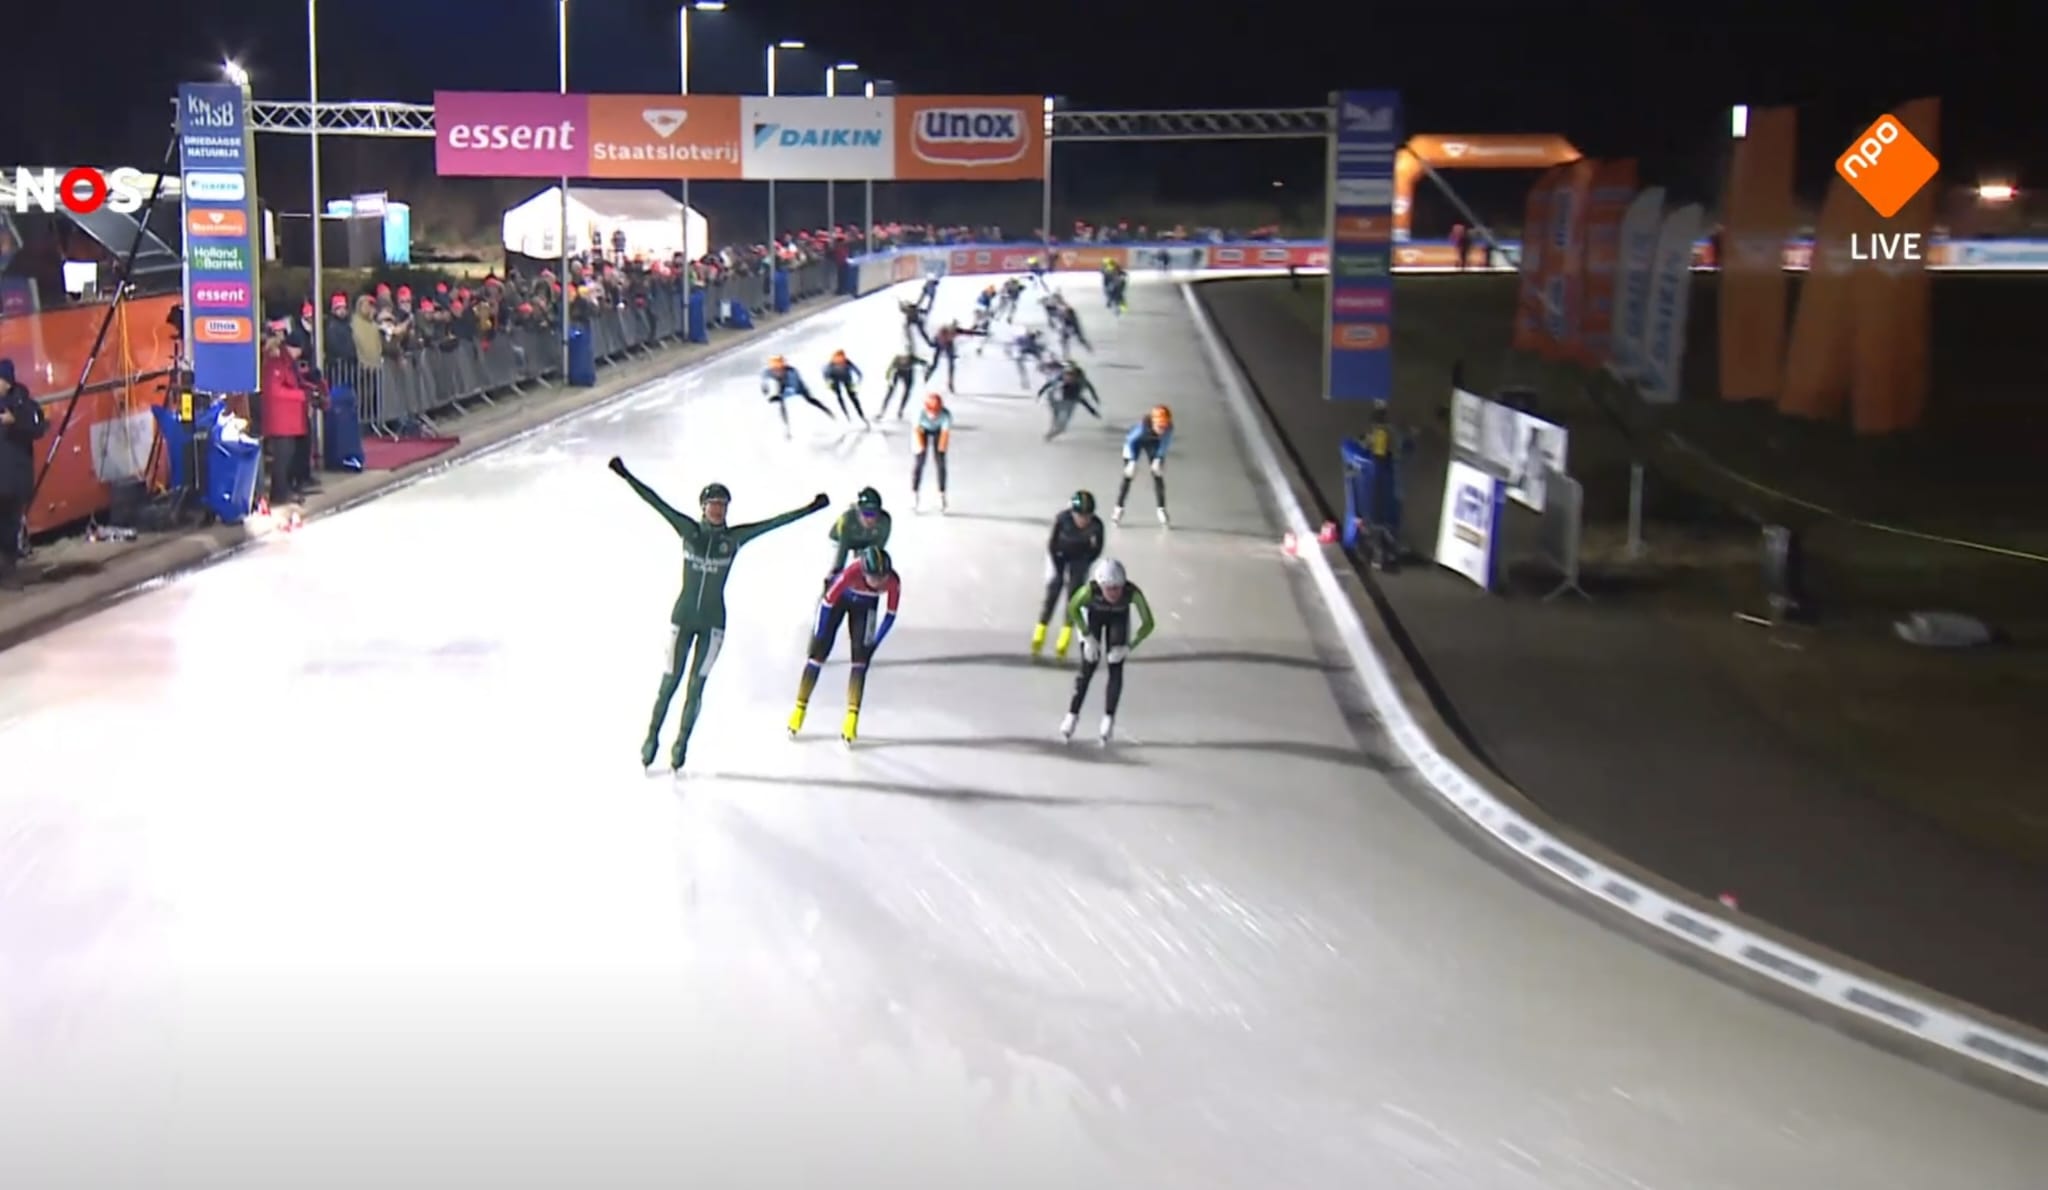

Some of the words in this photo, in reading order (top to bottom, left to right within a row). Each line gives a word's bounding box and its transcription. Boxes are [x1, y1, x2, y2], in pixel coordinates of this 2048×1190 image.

[925, 111, 1015, 138] unox
[184, 136, 241, 147] DRIEDAAGSE
[449, 120, 575, 150] essent
[779, 129, 882, 147] DAIKIN
[187, 148, 240, 158] NATUURIJS
[593, 142, 739, 164] Staatsloterij
[194, 246, 238, 259] Holland
[204, 258, 243, 271] Barrett
[197, 289, 244, 301] essent
